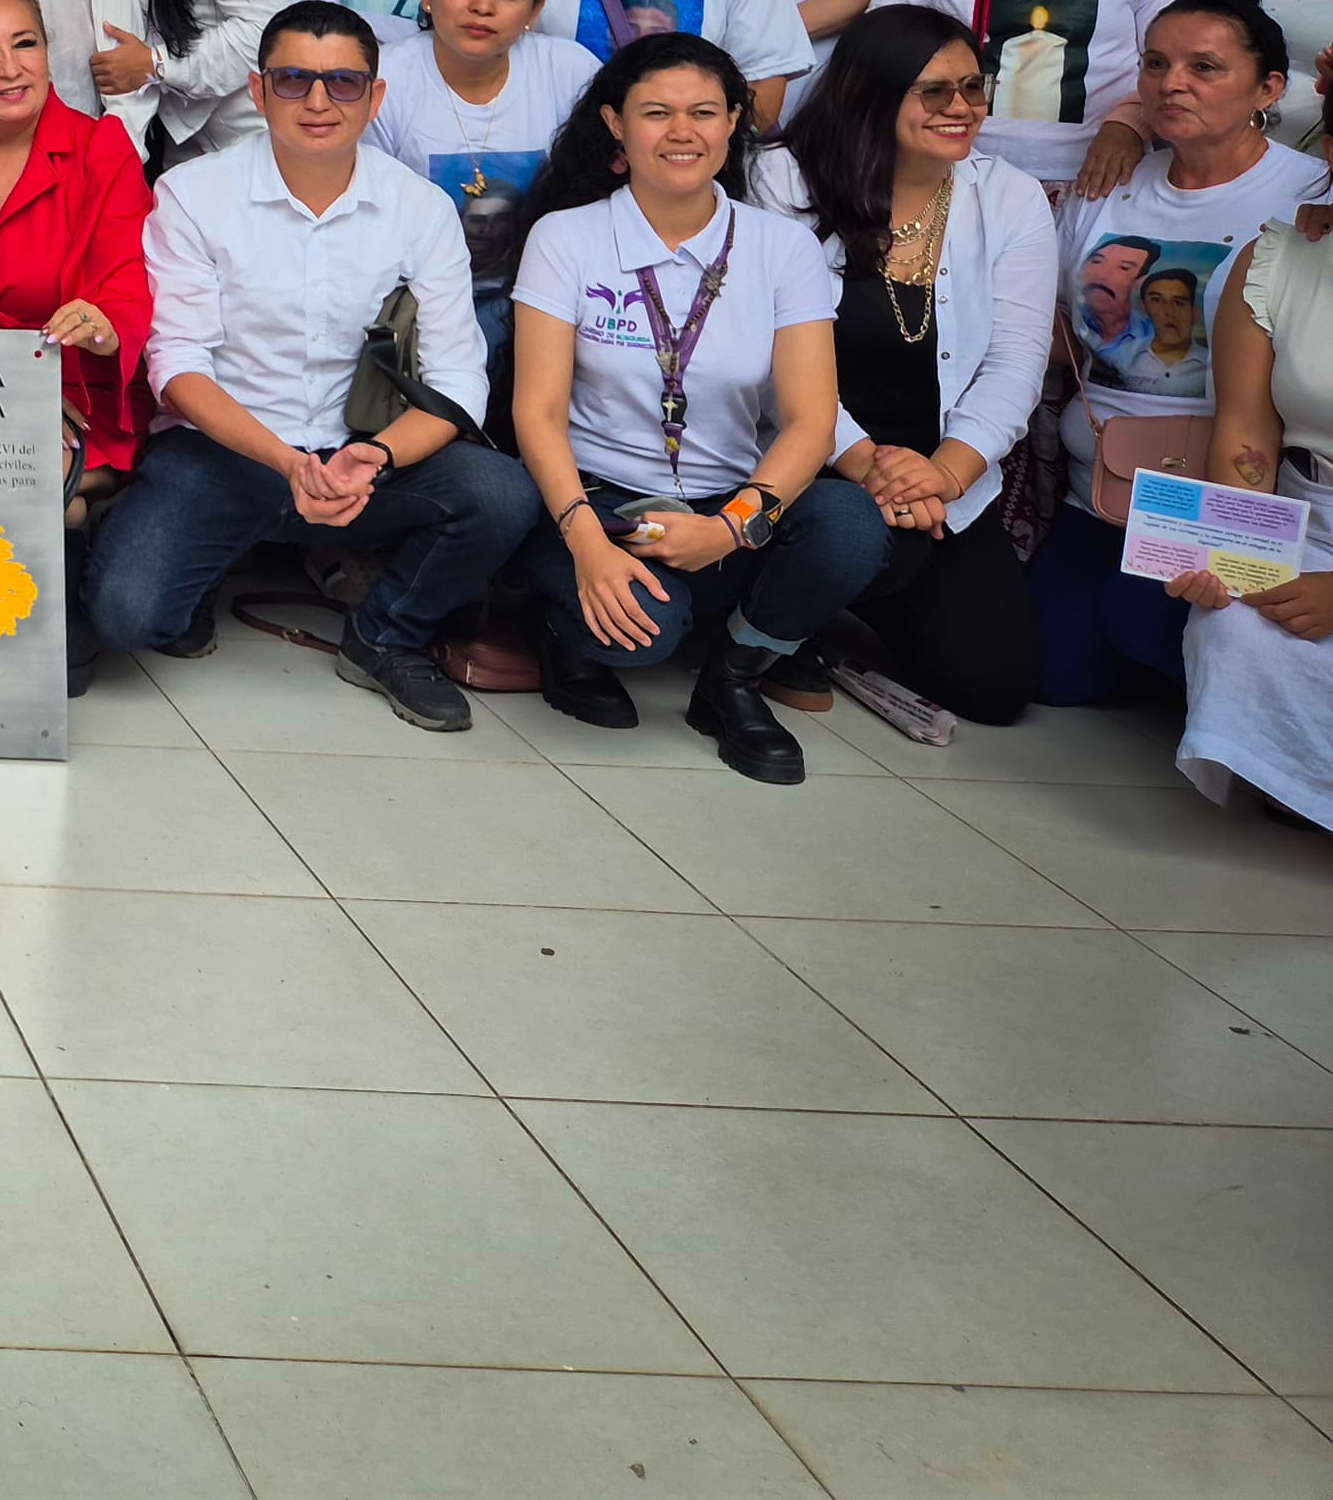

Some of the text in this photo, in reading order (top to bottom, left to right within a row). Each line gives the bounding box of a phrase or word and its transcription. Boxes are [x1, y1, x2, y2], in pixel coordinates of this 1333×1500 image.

[595, 315, 638, 333] UBPD
[18, 443, 35, 455] del
[11, 477, 36, 489] para
